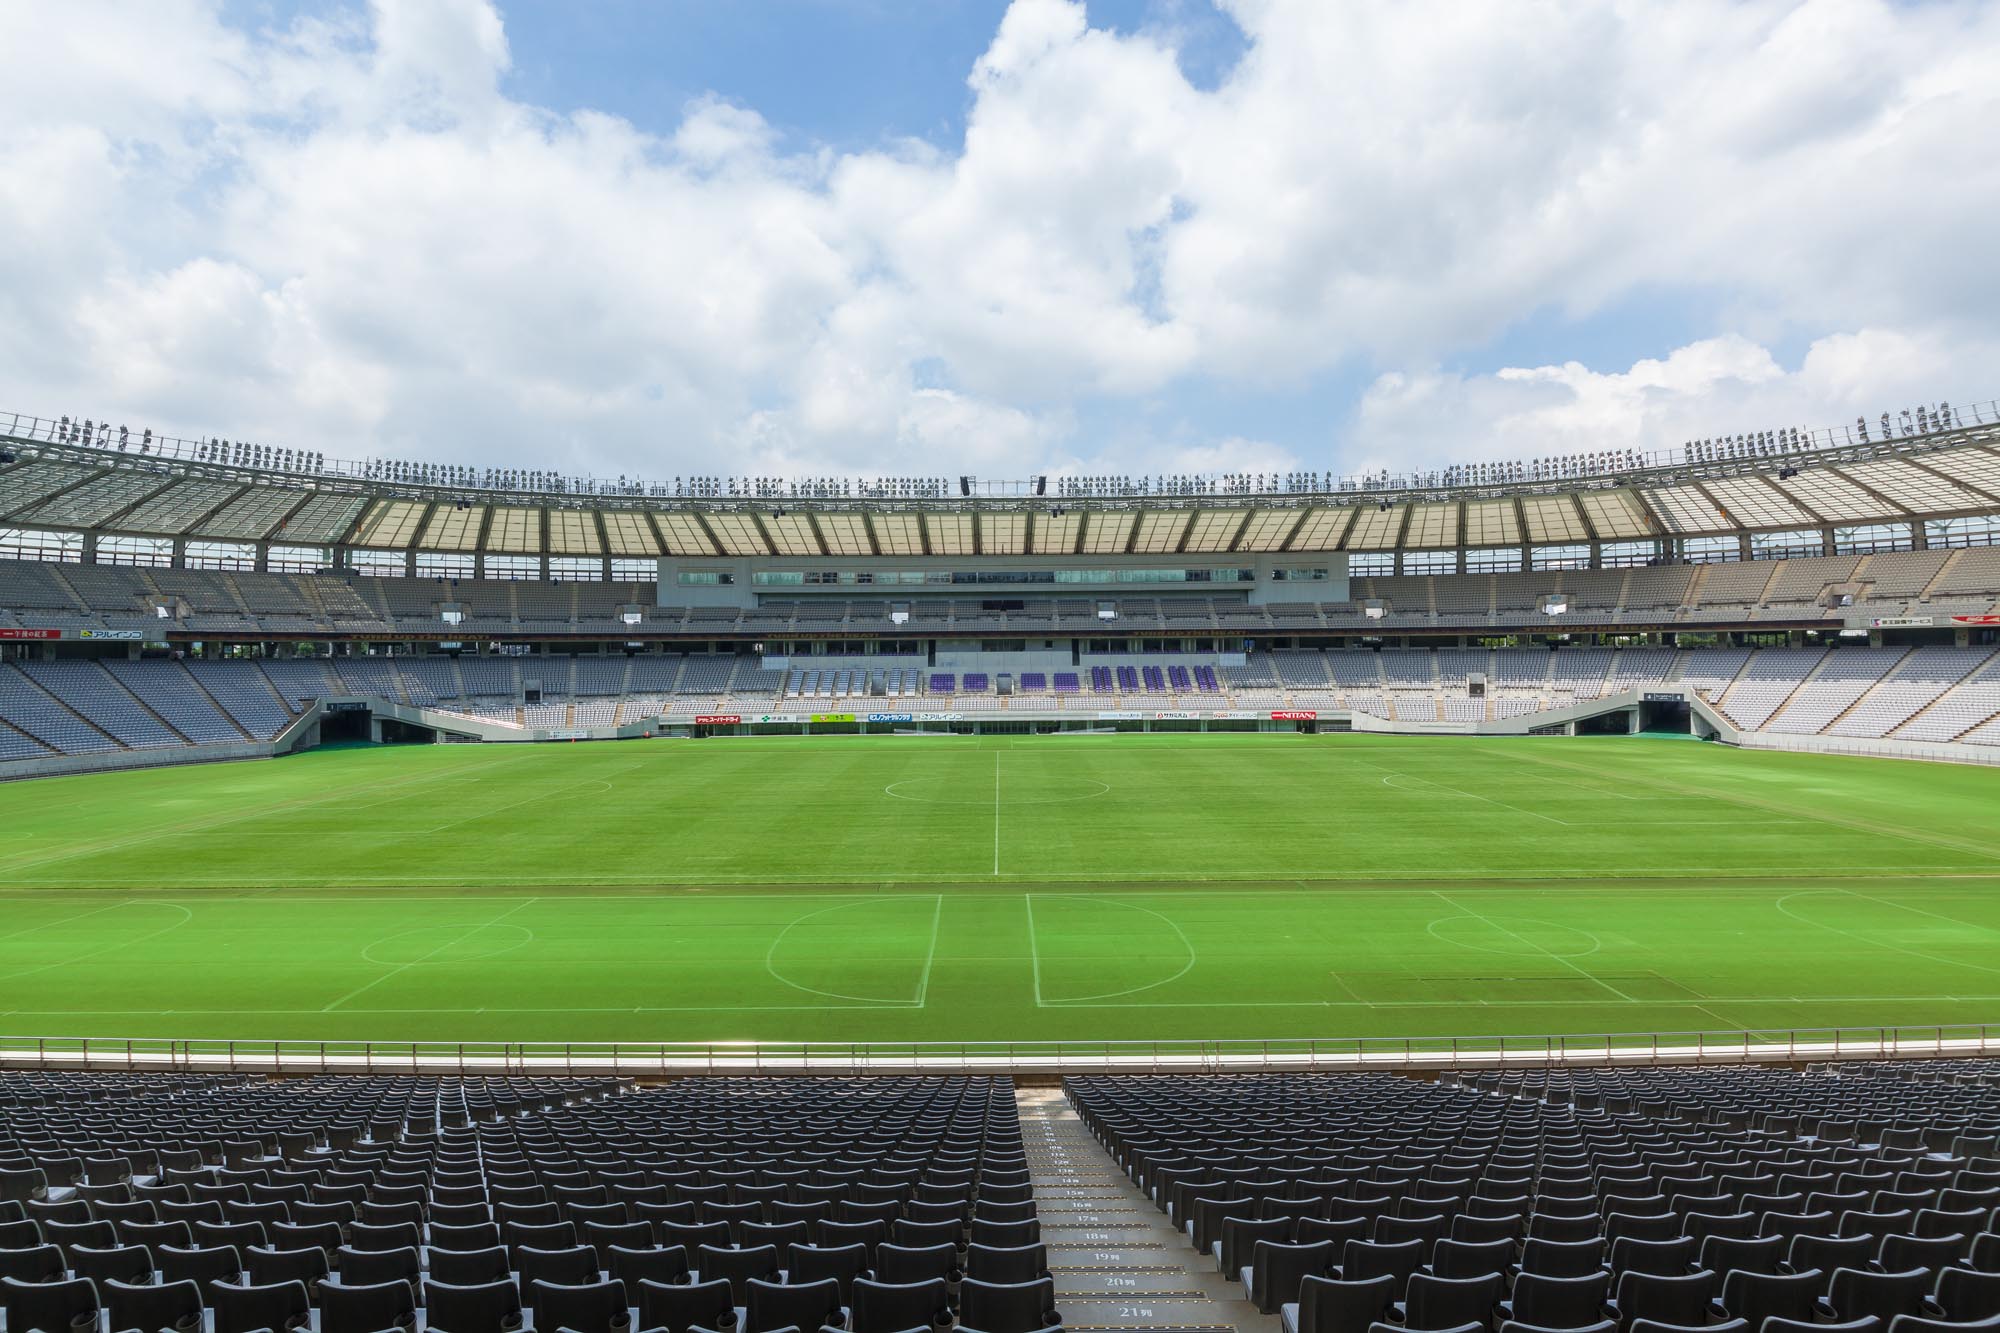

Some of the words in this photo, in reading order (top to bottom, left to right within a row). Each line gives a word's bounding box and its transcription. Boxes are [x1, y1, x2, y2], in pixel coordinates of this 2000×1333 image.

[93, 631, 142, 639] アルインコ
[929, 713, 963, 721] アルインコ
[1105, 1277, 1136, 1287] 20列
[1119, 1307, 1153, 1317] 21列
